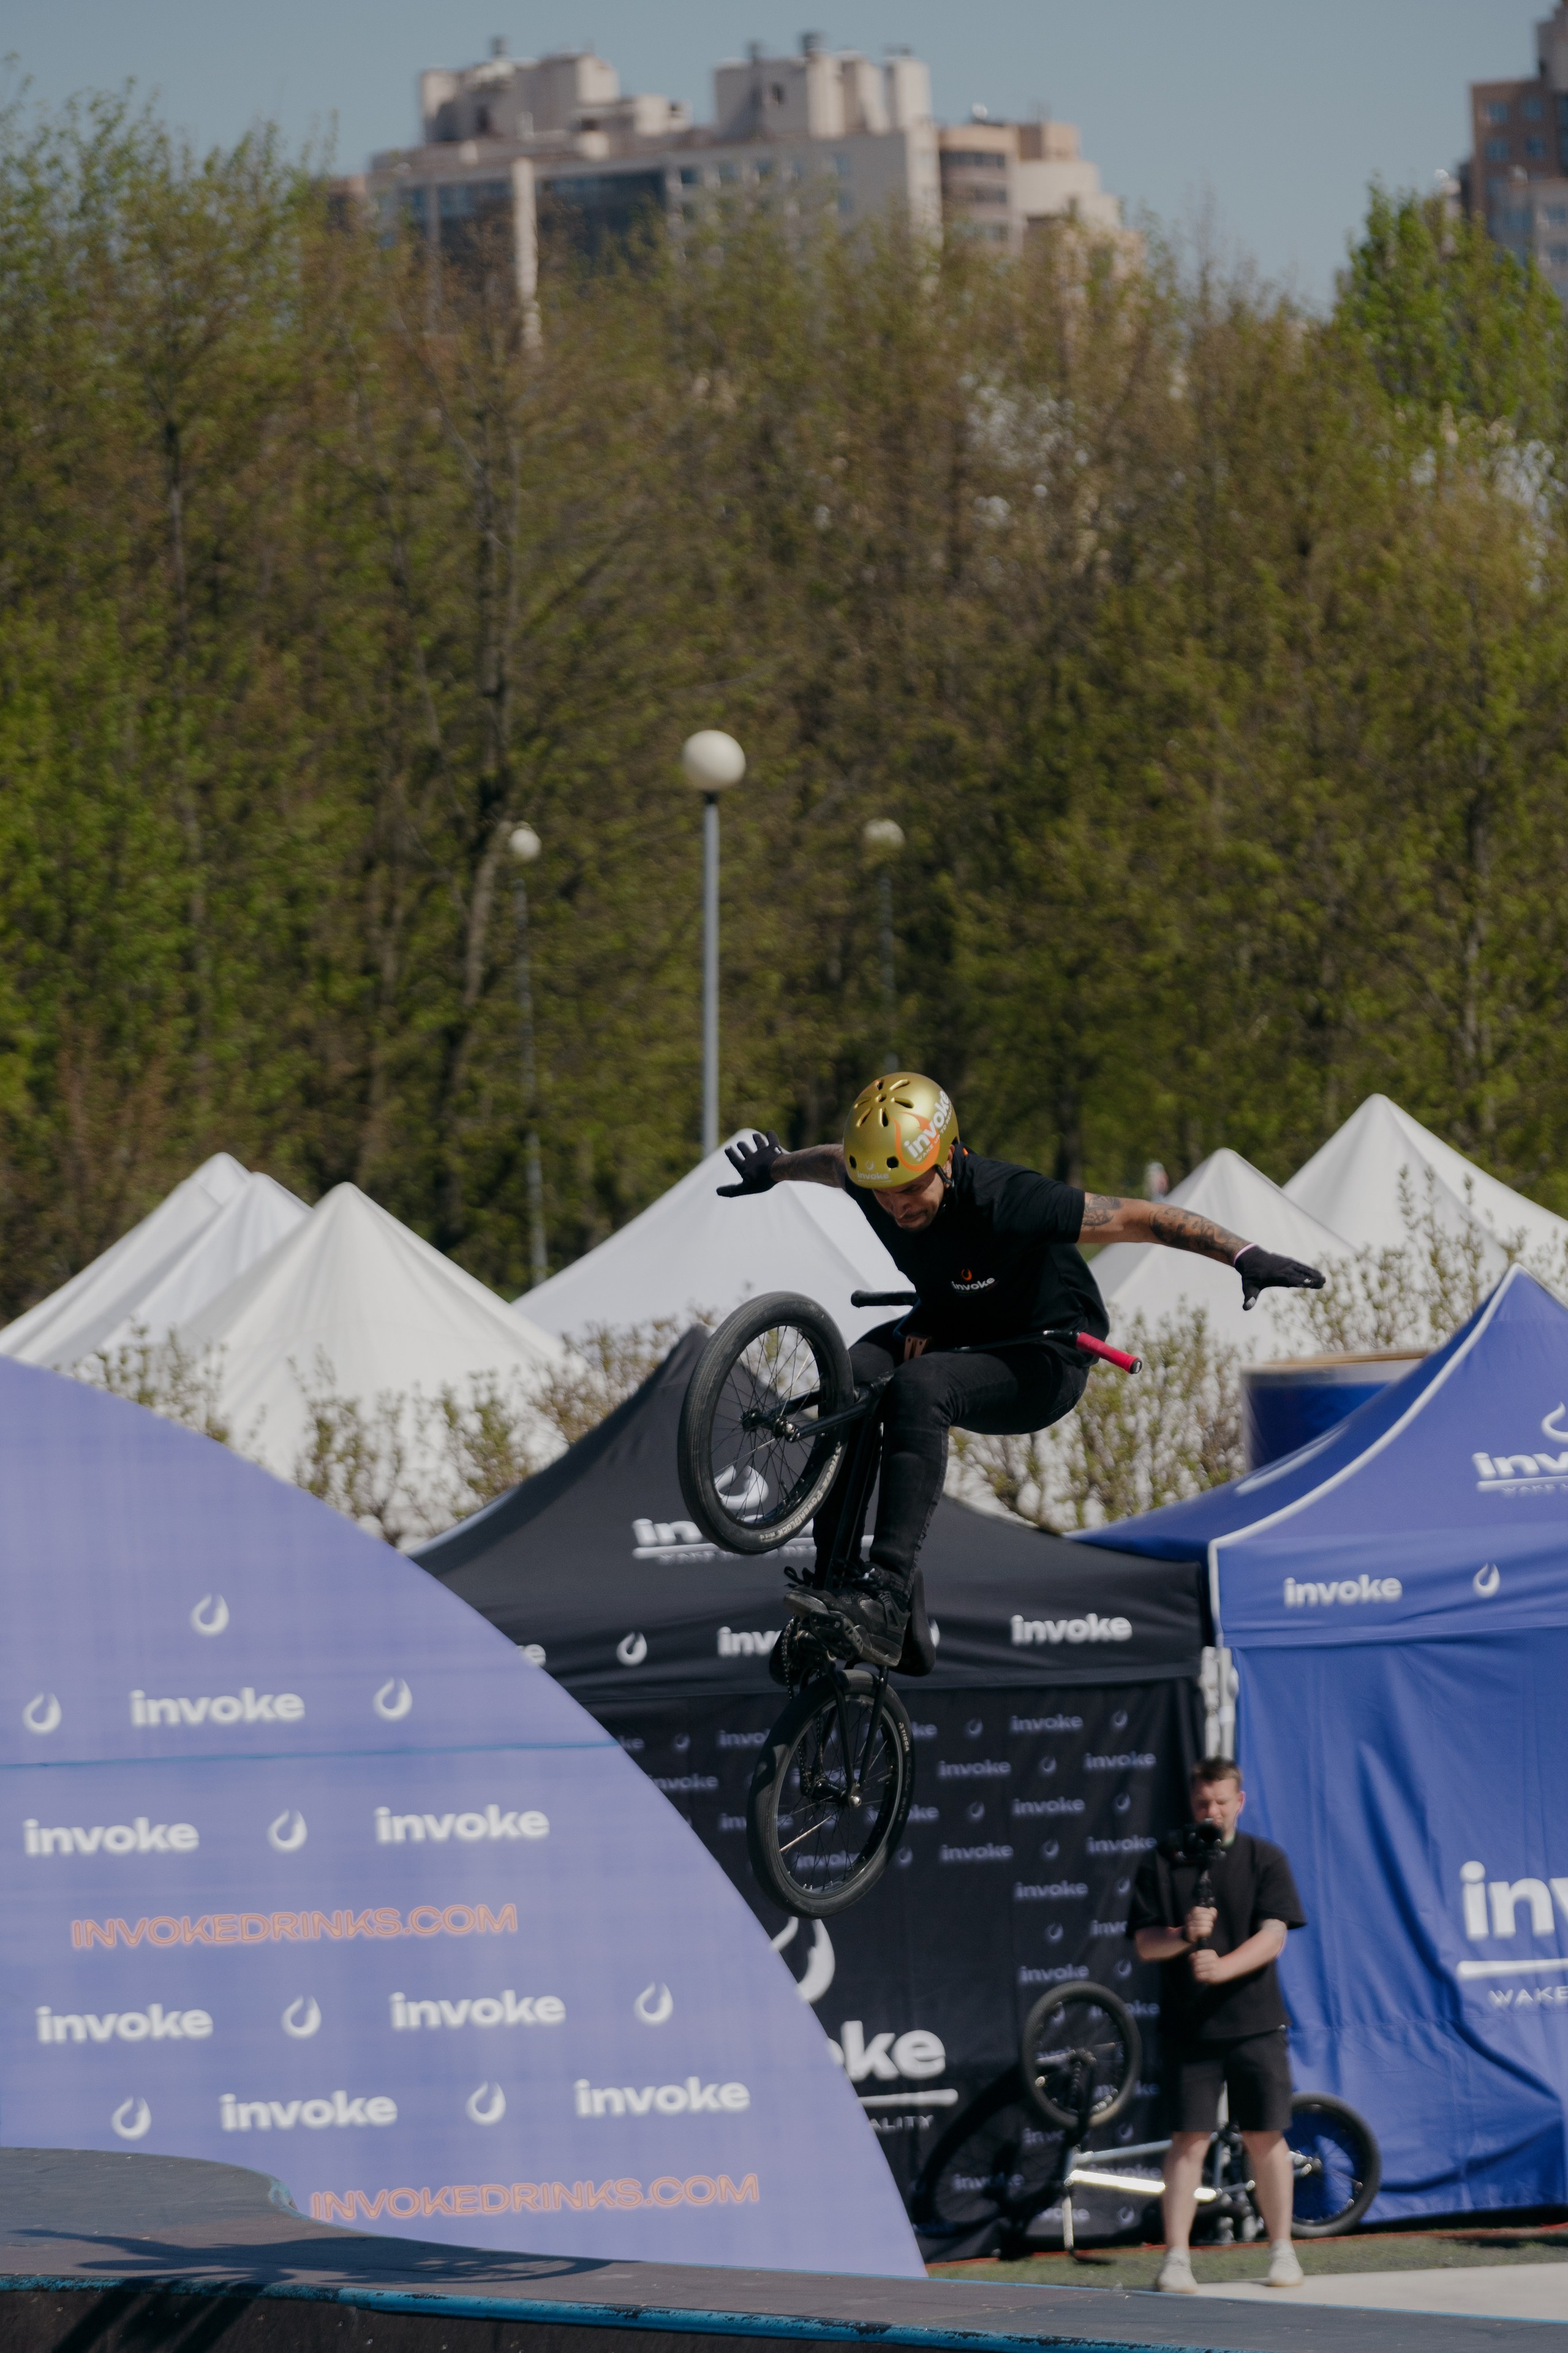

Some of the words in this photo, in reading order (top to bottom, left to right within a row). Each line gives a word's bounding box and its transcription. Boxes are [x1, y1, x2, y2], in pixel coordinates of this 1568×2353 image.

[903, 1090, 949, 1158] invoke
[917, 1143, 934, 1162] WAKE
[933, 1134, 941, 1144] UP
[940, 1124, 947, 1134] TO
[857, 1170, 890, 1179] invoke
[951, 1277, 995, 1291] invoke
[777, 1490, 824, 1538] POWERBLOCK
[1284, 1574, 1402, 1606] invoke
[718, 1626, 783, 1656] inv
[1011, 1613, 1133, 1644] invoke
[130, 1687, 305, 1726] invoke
[1011, 1714, 1083, 1734] invoke
[901, 1729, 910, 1752] TIOGA
[938, 1759, 1011, 1778] invoke
[1085, 1751, 1156, 1770] invoke
[1013, 1796, 1085, 1816] invoke
[23, 1816, 200, 1856] invoke
[375, 1804, 550, 1843] invoke
[941, 1842, 1014, 1862] invoke
[1087, 1835, 1157, 1854] invoke
[1015, 1879, 1088, 1899] invoke
[72, 1903, 518, 1947] INVOKEDRINKS.COM
[1019, 1963, 1090, 1984] invoke
[37, 2003, 213, 2043] invoke
[391, 1990, 565, 2029] invoke
[220, 2090, 398, 2131] invoke
[575, 2077, 750, 2116] invoke
[870, 2115, 934, 2133] ALITY
[312, 2174, 759, 2219] INVOKEDRINKS.COM
